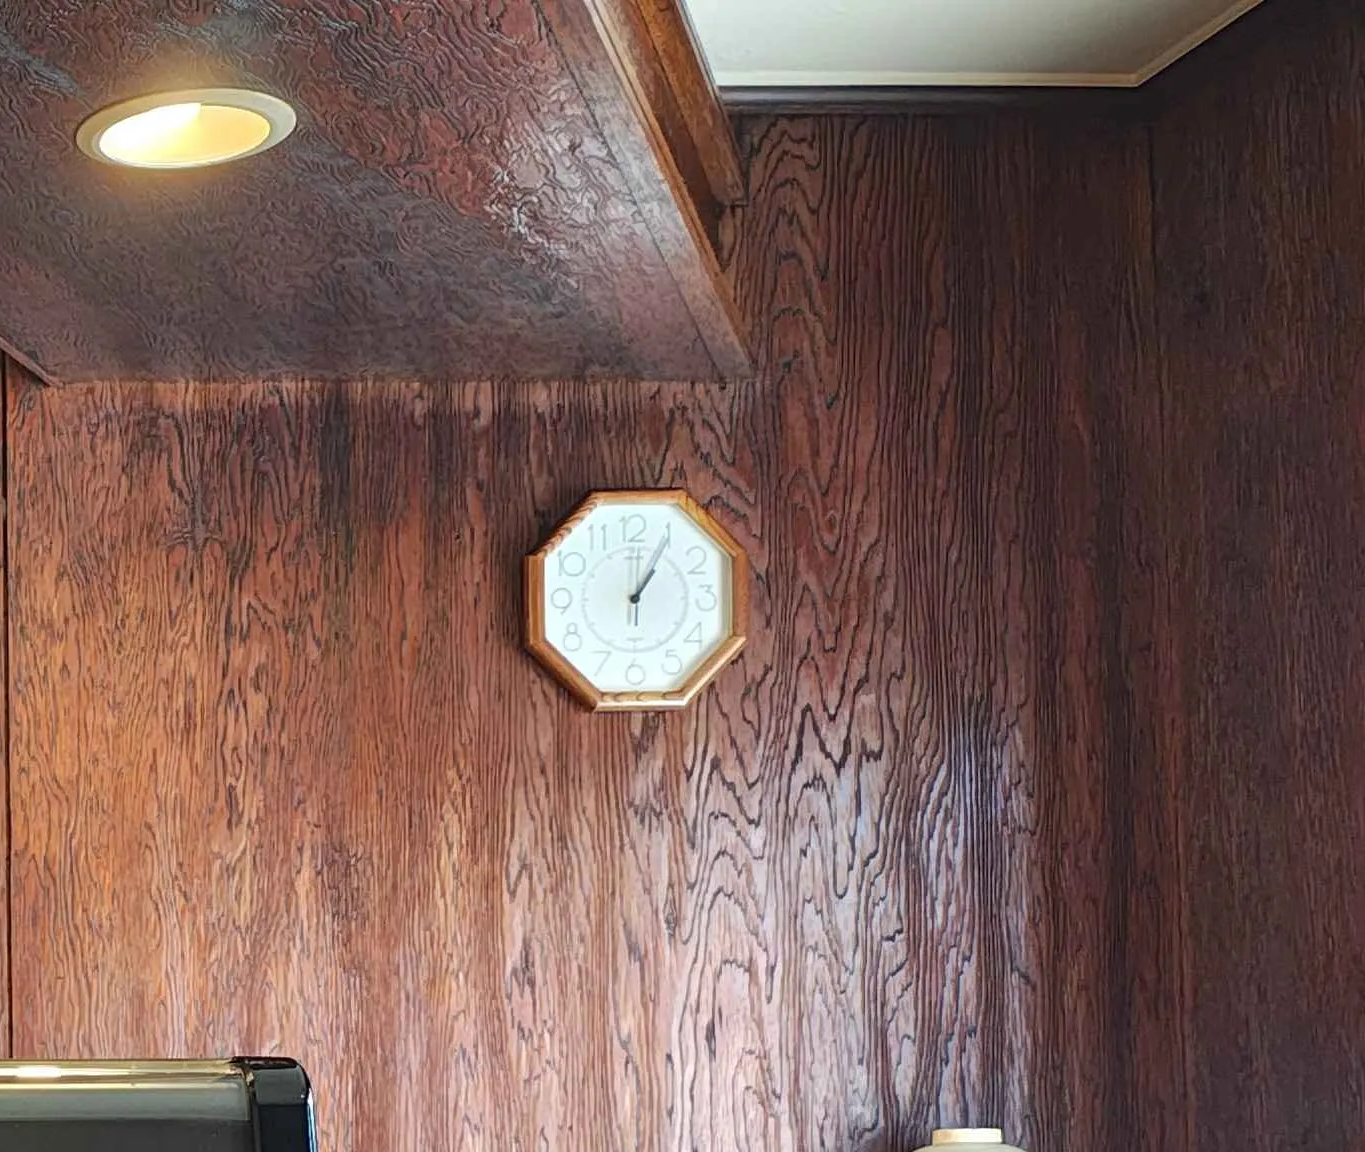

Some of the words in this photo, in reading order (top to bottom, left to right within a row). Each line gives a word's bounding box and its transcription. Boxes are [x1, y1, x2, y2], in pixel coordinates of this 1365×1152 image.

[587, 523, 607, 551] 11
[619, 513, 647, 543] 12
[557, 551, 586, 577] 10
[685, 545, 707, 575] 2
[550, 587, 573, 615] 9
[695, 584, 717, 612] 3
[562, 622, 582, 652] 8
[683, 621, 703, 649] 4
[591, 650, 612, 677] 7
[625, 657, 646, 686] 6
[661, 648, 683, 675] 5
